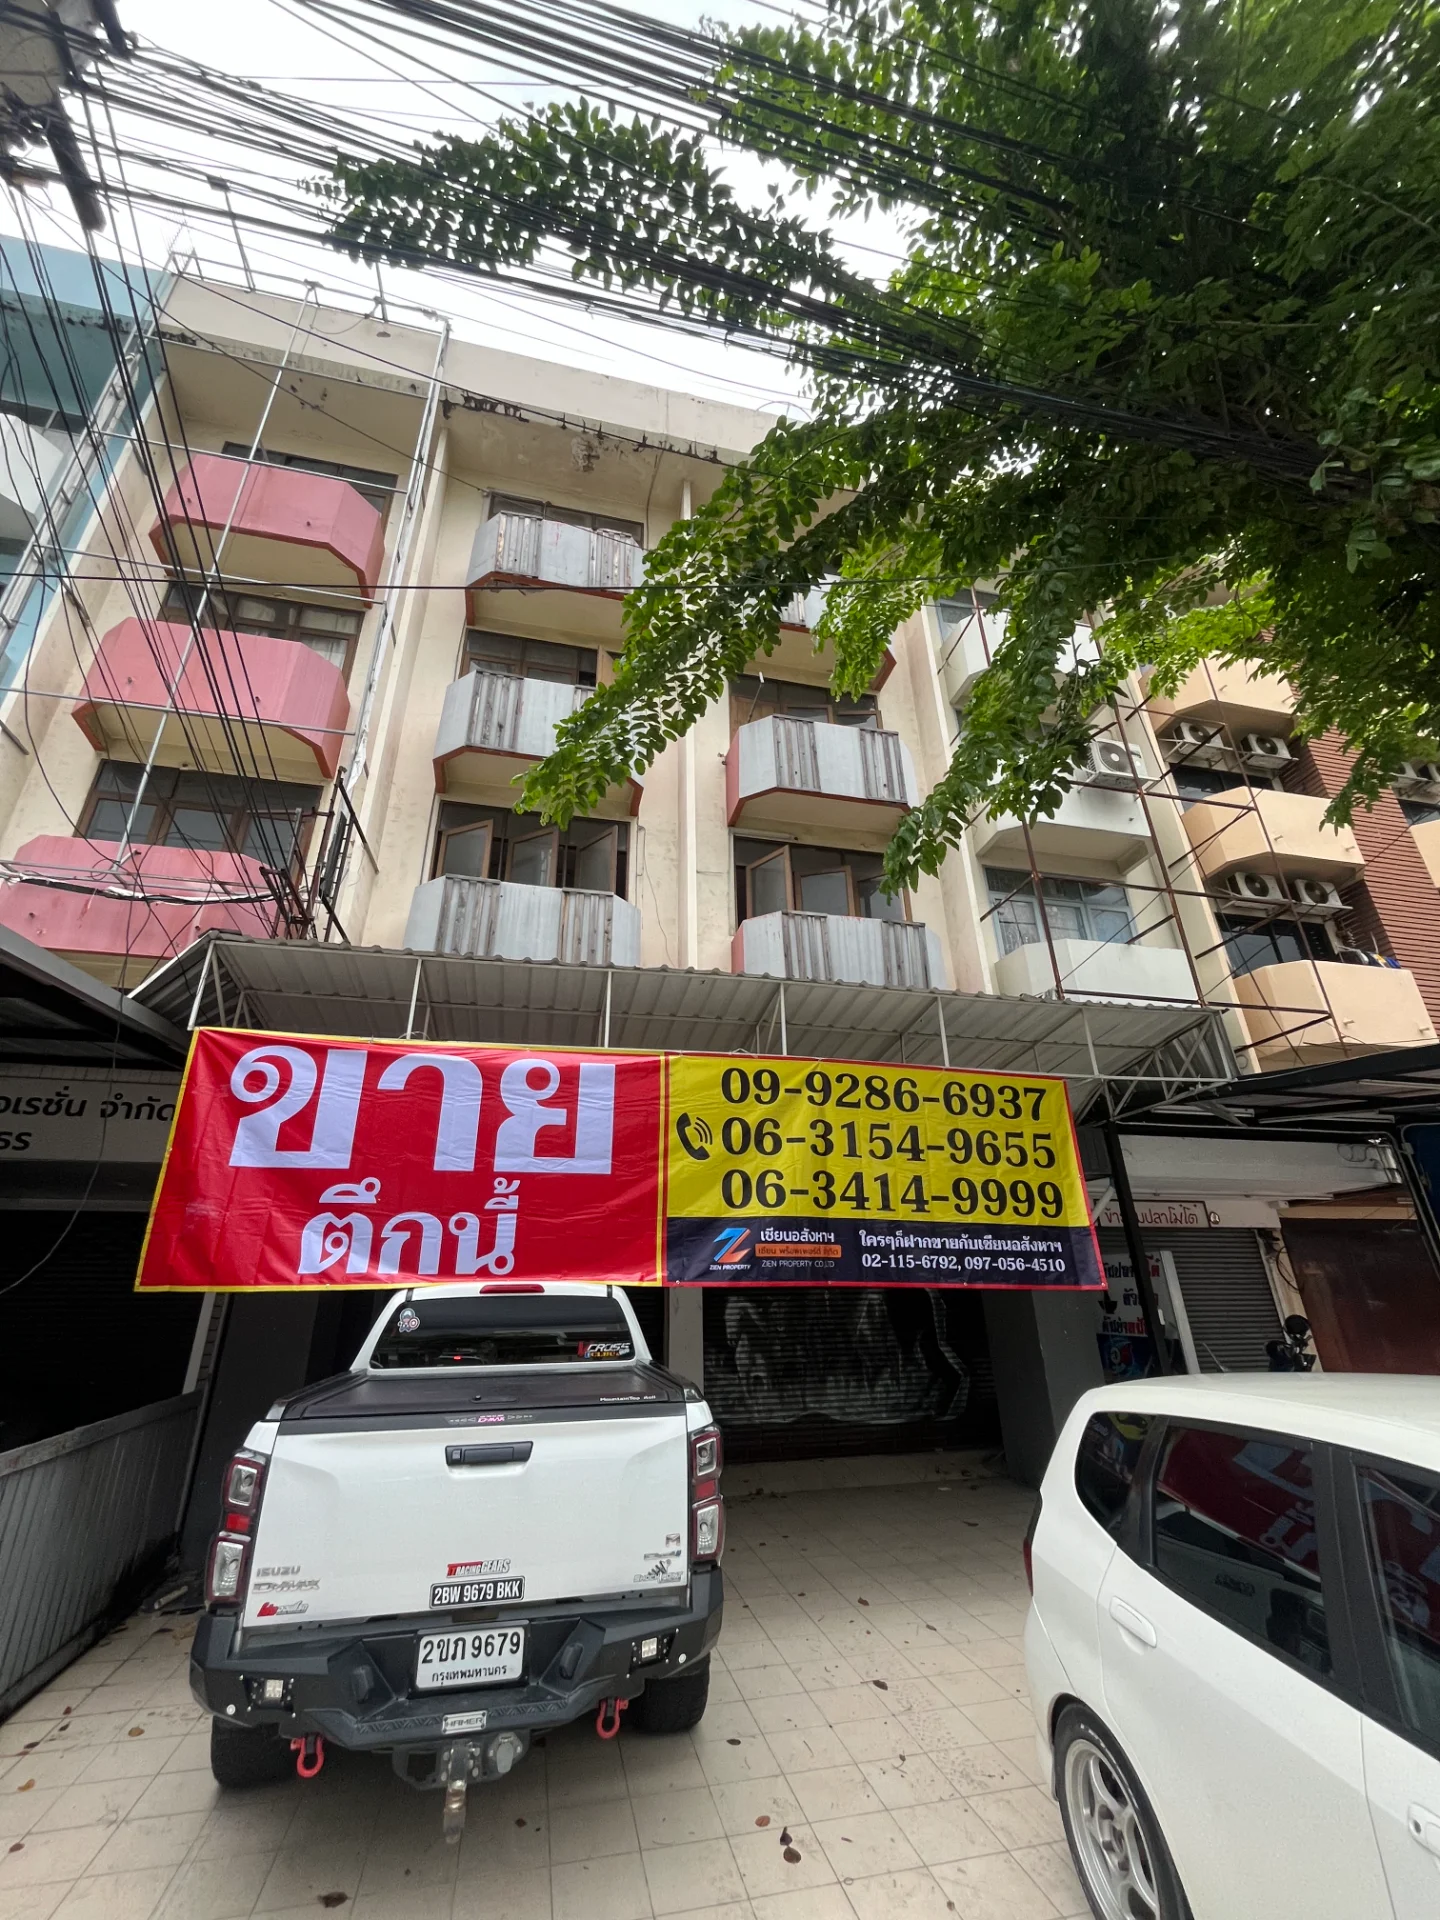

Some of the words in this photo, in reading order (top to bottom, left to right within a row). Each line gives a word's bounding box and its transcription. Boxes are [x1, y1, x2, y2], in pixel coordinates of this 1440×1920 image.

[720, 1067, 1047, 1122] 09-9286-6937
[228, 1045, 616, 1175] ขาย
[720, 1116, 1057, 1170] 06-3154-9655
[720, 1169, 1065, 1219] 06-3414-9999
[297, 1176, 520, 1276] ตึกนี้
[761, 1260, 777, 1268] ZIEN
[779, 1260, 812, 1268] PROPERTY
[861, 1253, 962, 1270] 02-115-6792,
[964, 1256, 1066, 1272] 097-056-4510
[256, 1565, 301, 1577] ISUZU
[434, 1585, 461, 1605] 2BW
[463, 1583, 494, 1602] 9679
[497, 1580, 520, 1599] BKK
[471, 1631, 520, 1658] 9679
[432, 1665, 507, 1686] กรุงเทพมหานคร
